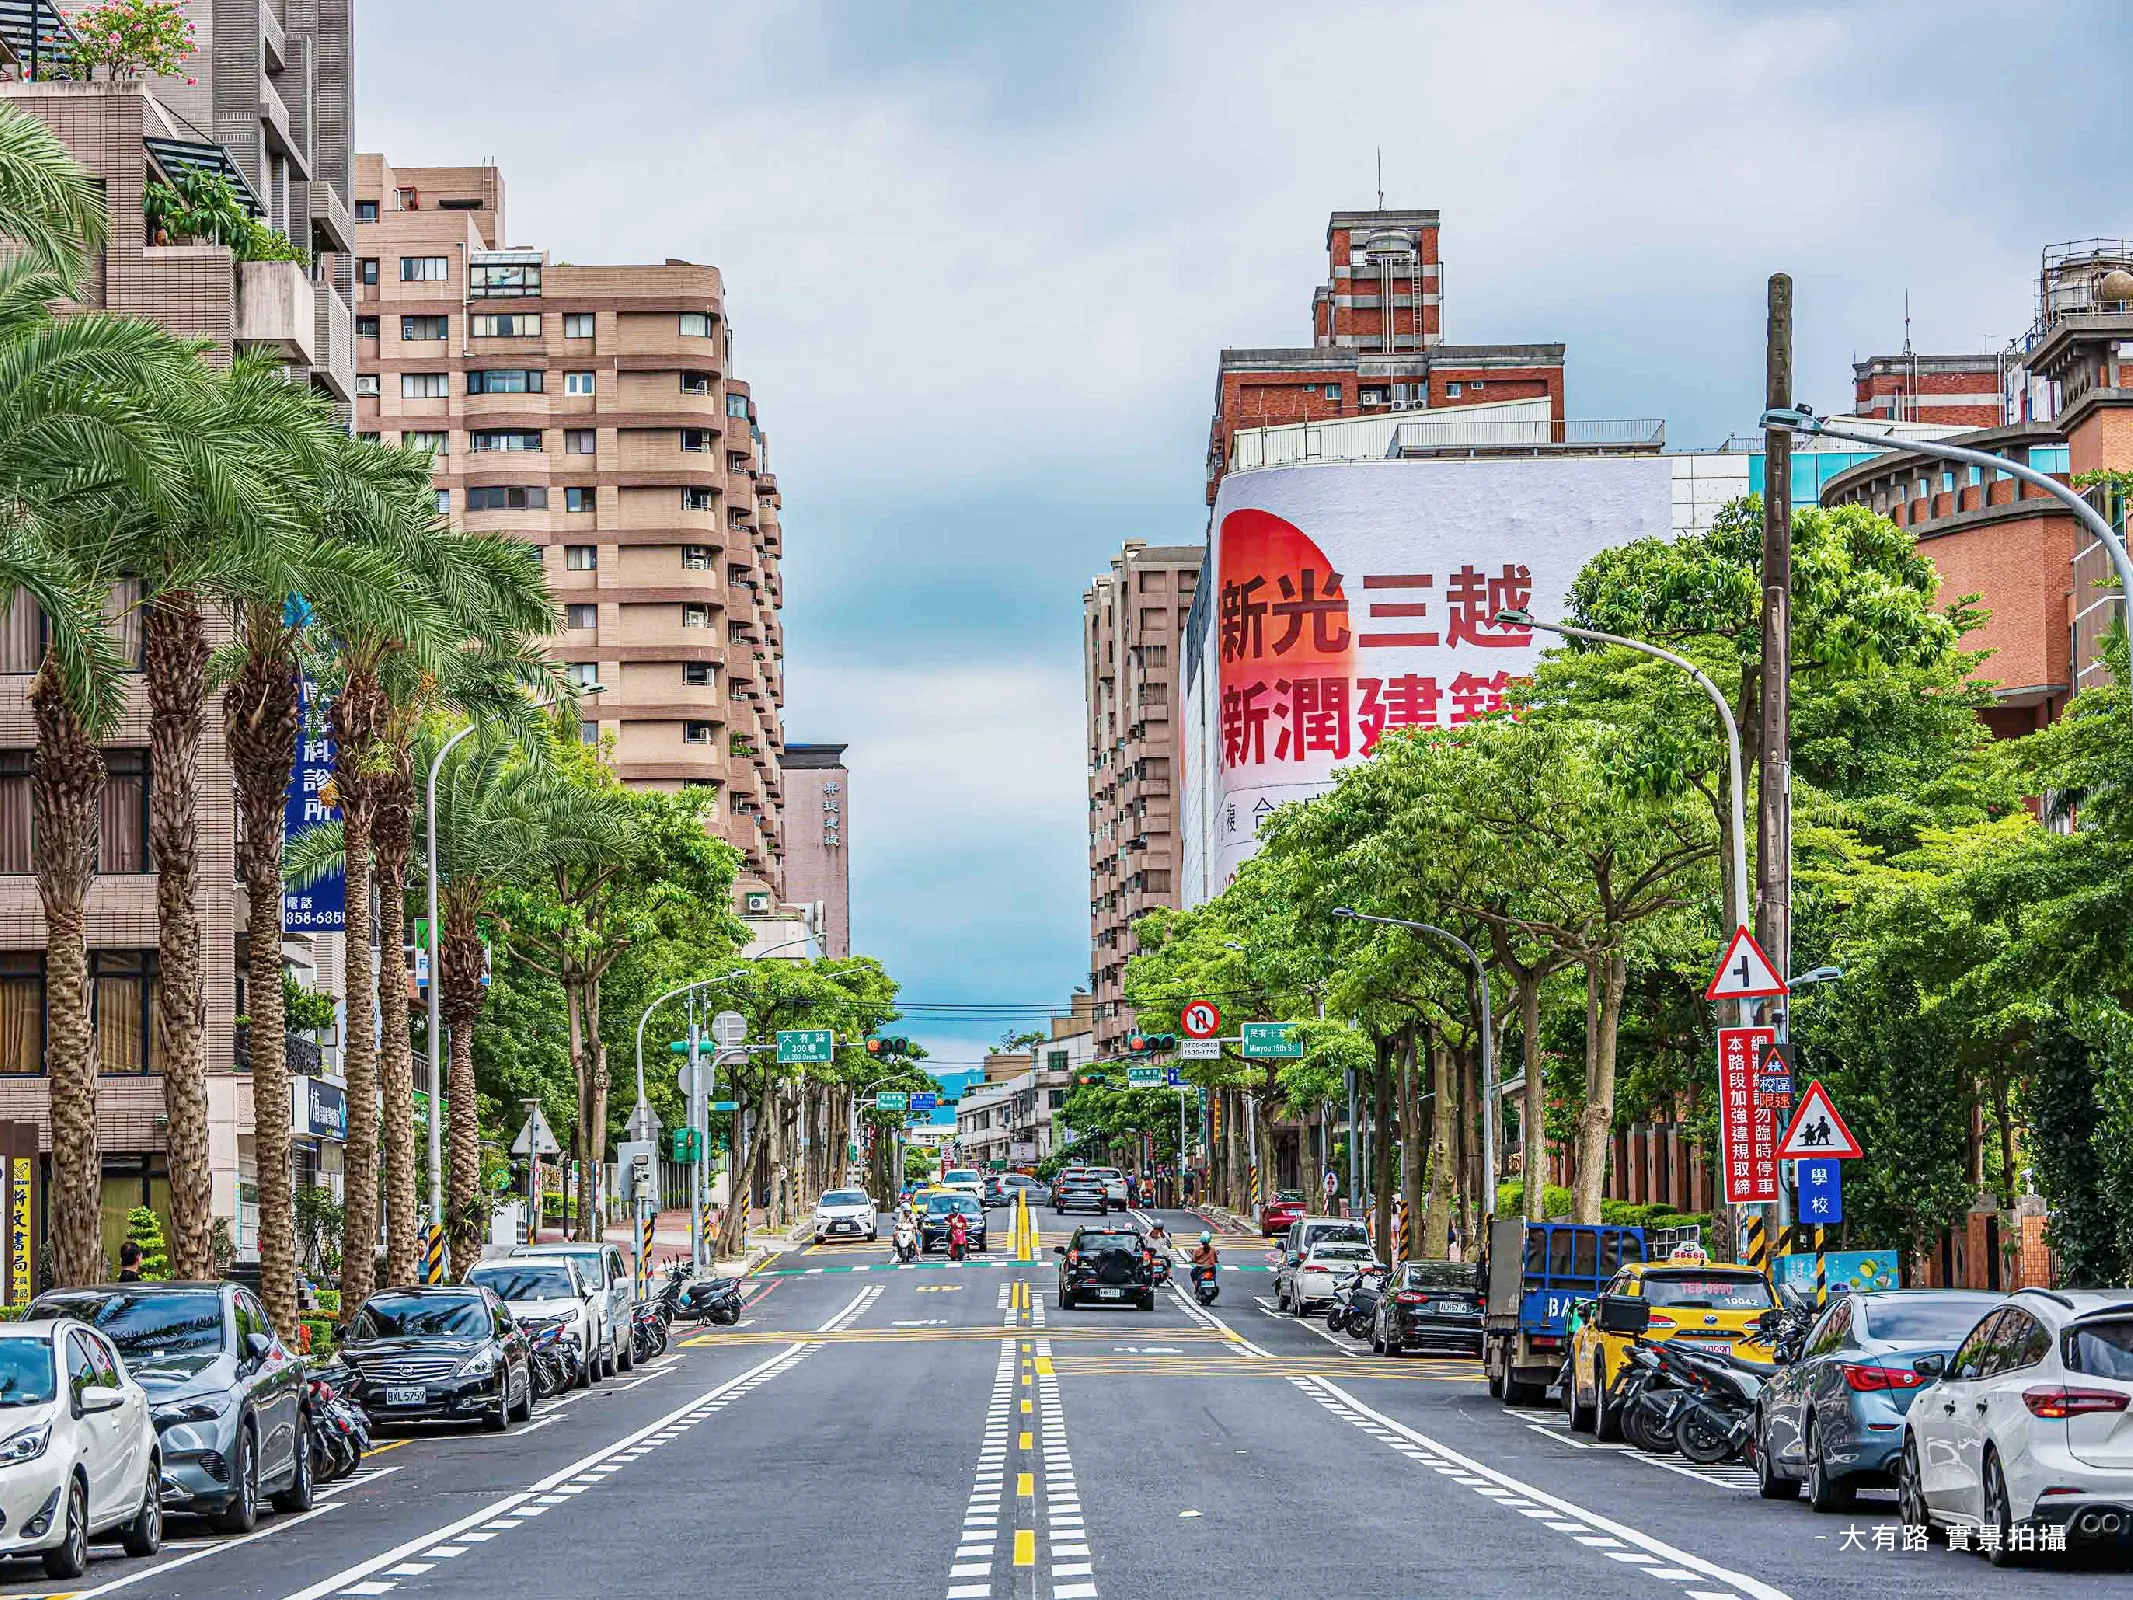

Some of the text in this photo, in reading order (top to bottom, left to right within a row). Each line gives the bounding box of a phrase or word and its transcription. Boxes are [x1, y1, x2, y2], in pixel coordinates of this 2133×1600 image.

[1220, 564, 1534, 663] 新光三越
[286, 896, 313, 910] 電話
[783, 1033, 826, 1044] 大有路
[1273, 1044, 1286, 1052] 15th
[1760, 1076, 1790, 1093] 校區
[1760, 1093, 1791, 1109] 限速
[1728, 1036, 1750, 1195] 本路段加強違規取締
[1811, 1168, 1829, 1214] 學校
[1674, 1251, 1705, 1259] 55688
[1724, 1297, 1759, 1306] 10042
